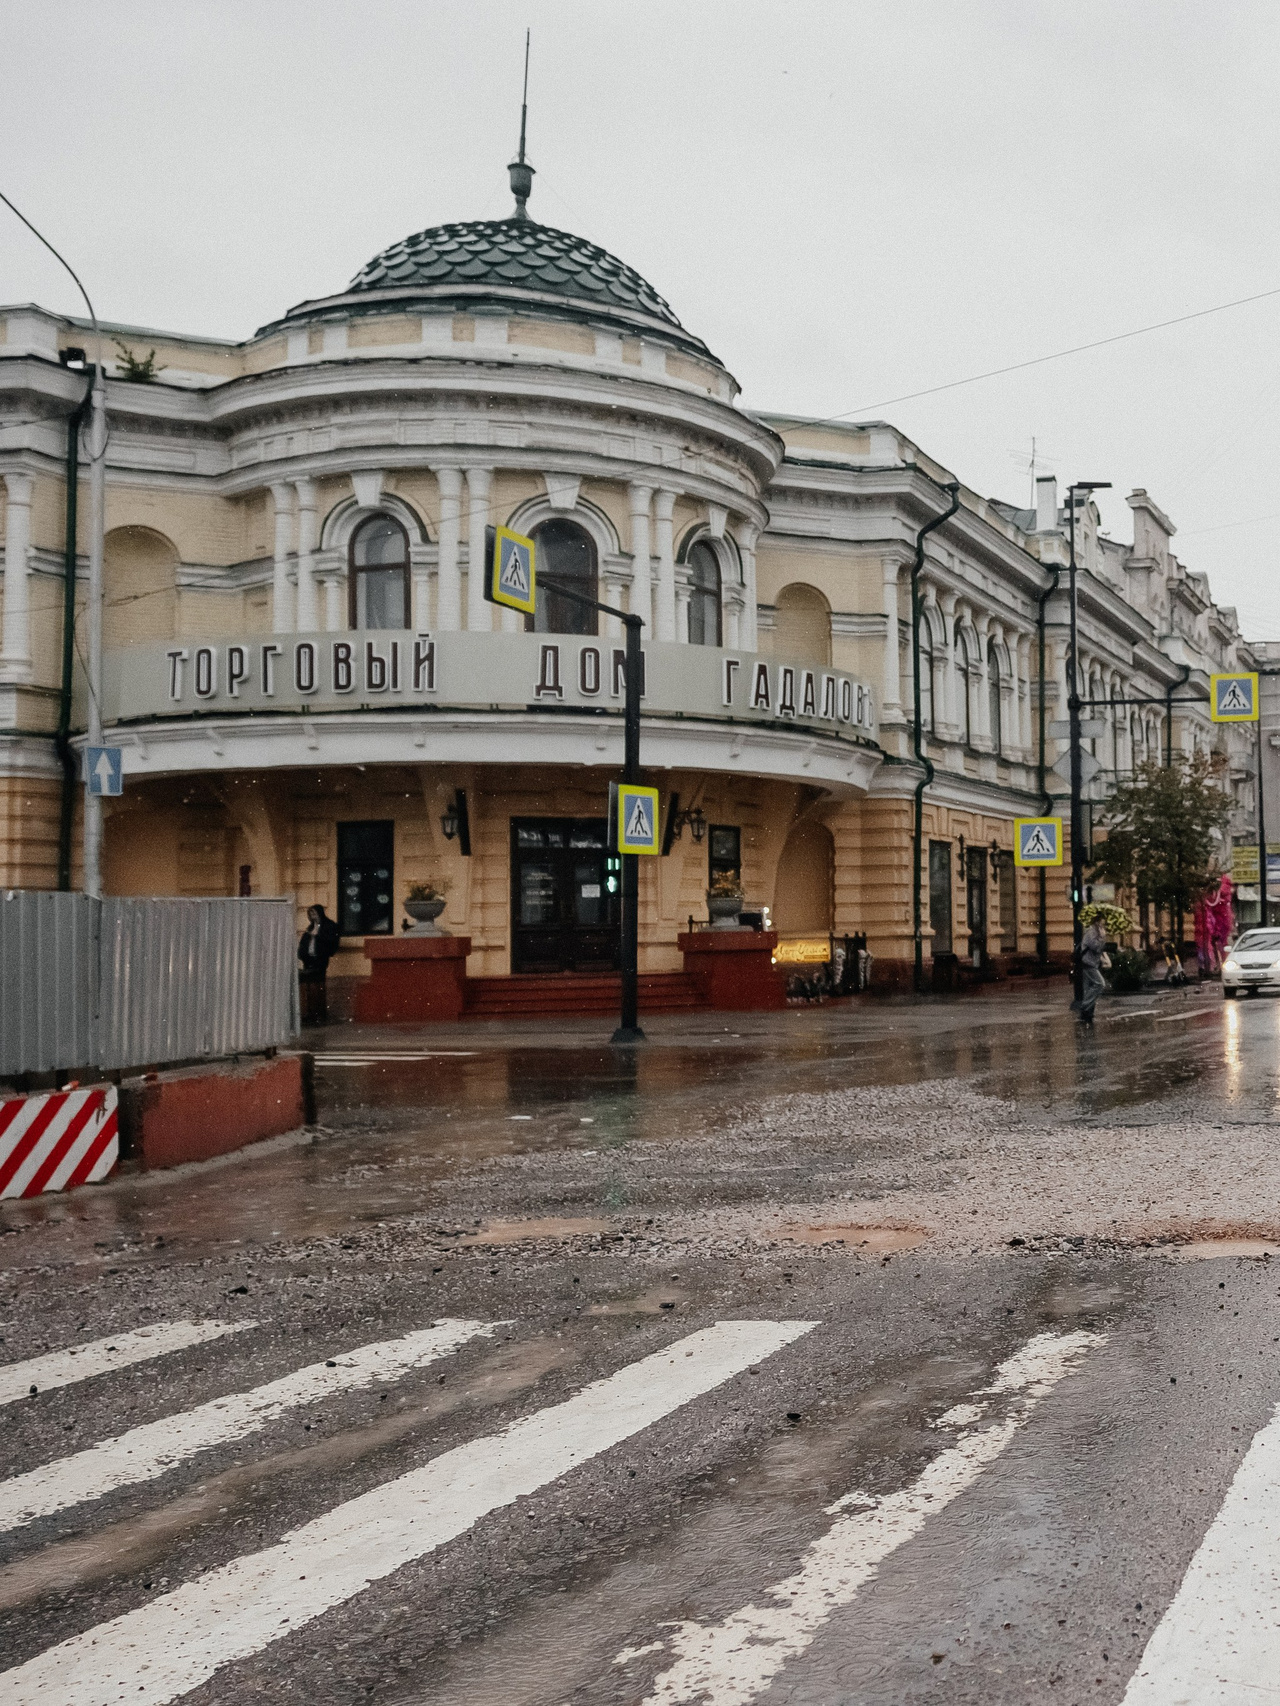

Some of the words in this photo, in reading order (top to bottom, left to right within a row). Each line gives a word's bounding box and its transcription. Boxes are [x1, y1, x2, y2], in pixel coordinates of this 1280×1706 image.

[166, 633, 437, 701] ТОРГОВЫЙ
[533, 643, 646, 701] ДОМ
[722, 658, 874, 730] ГАДАЛОВЪ
